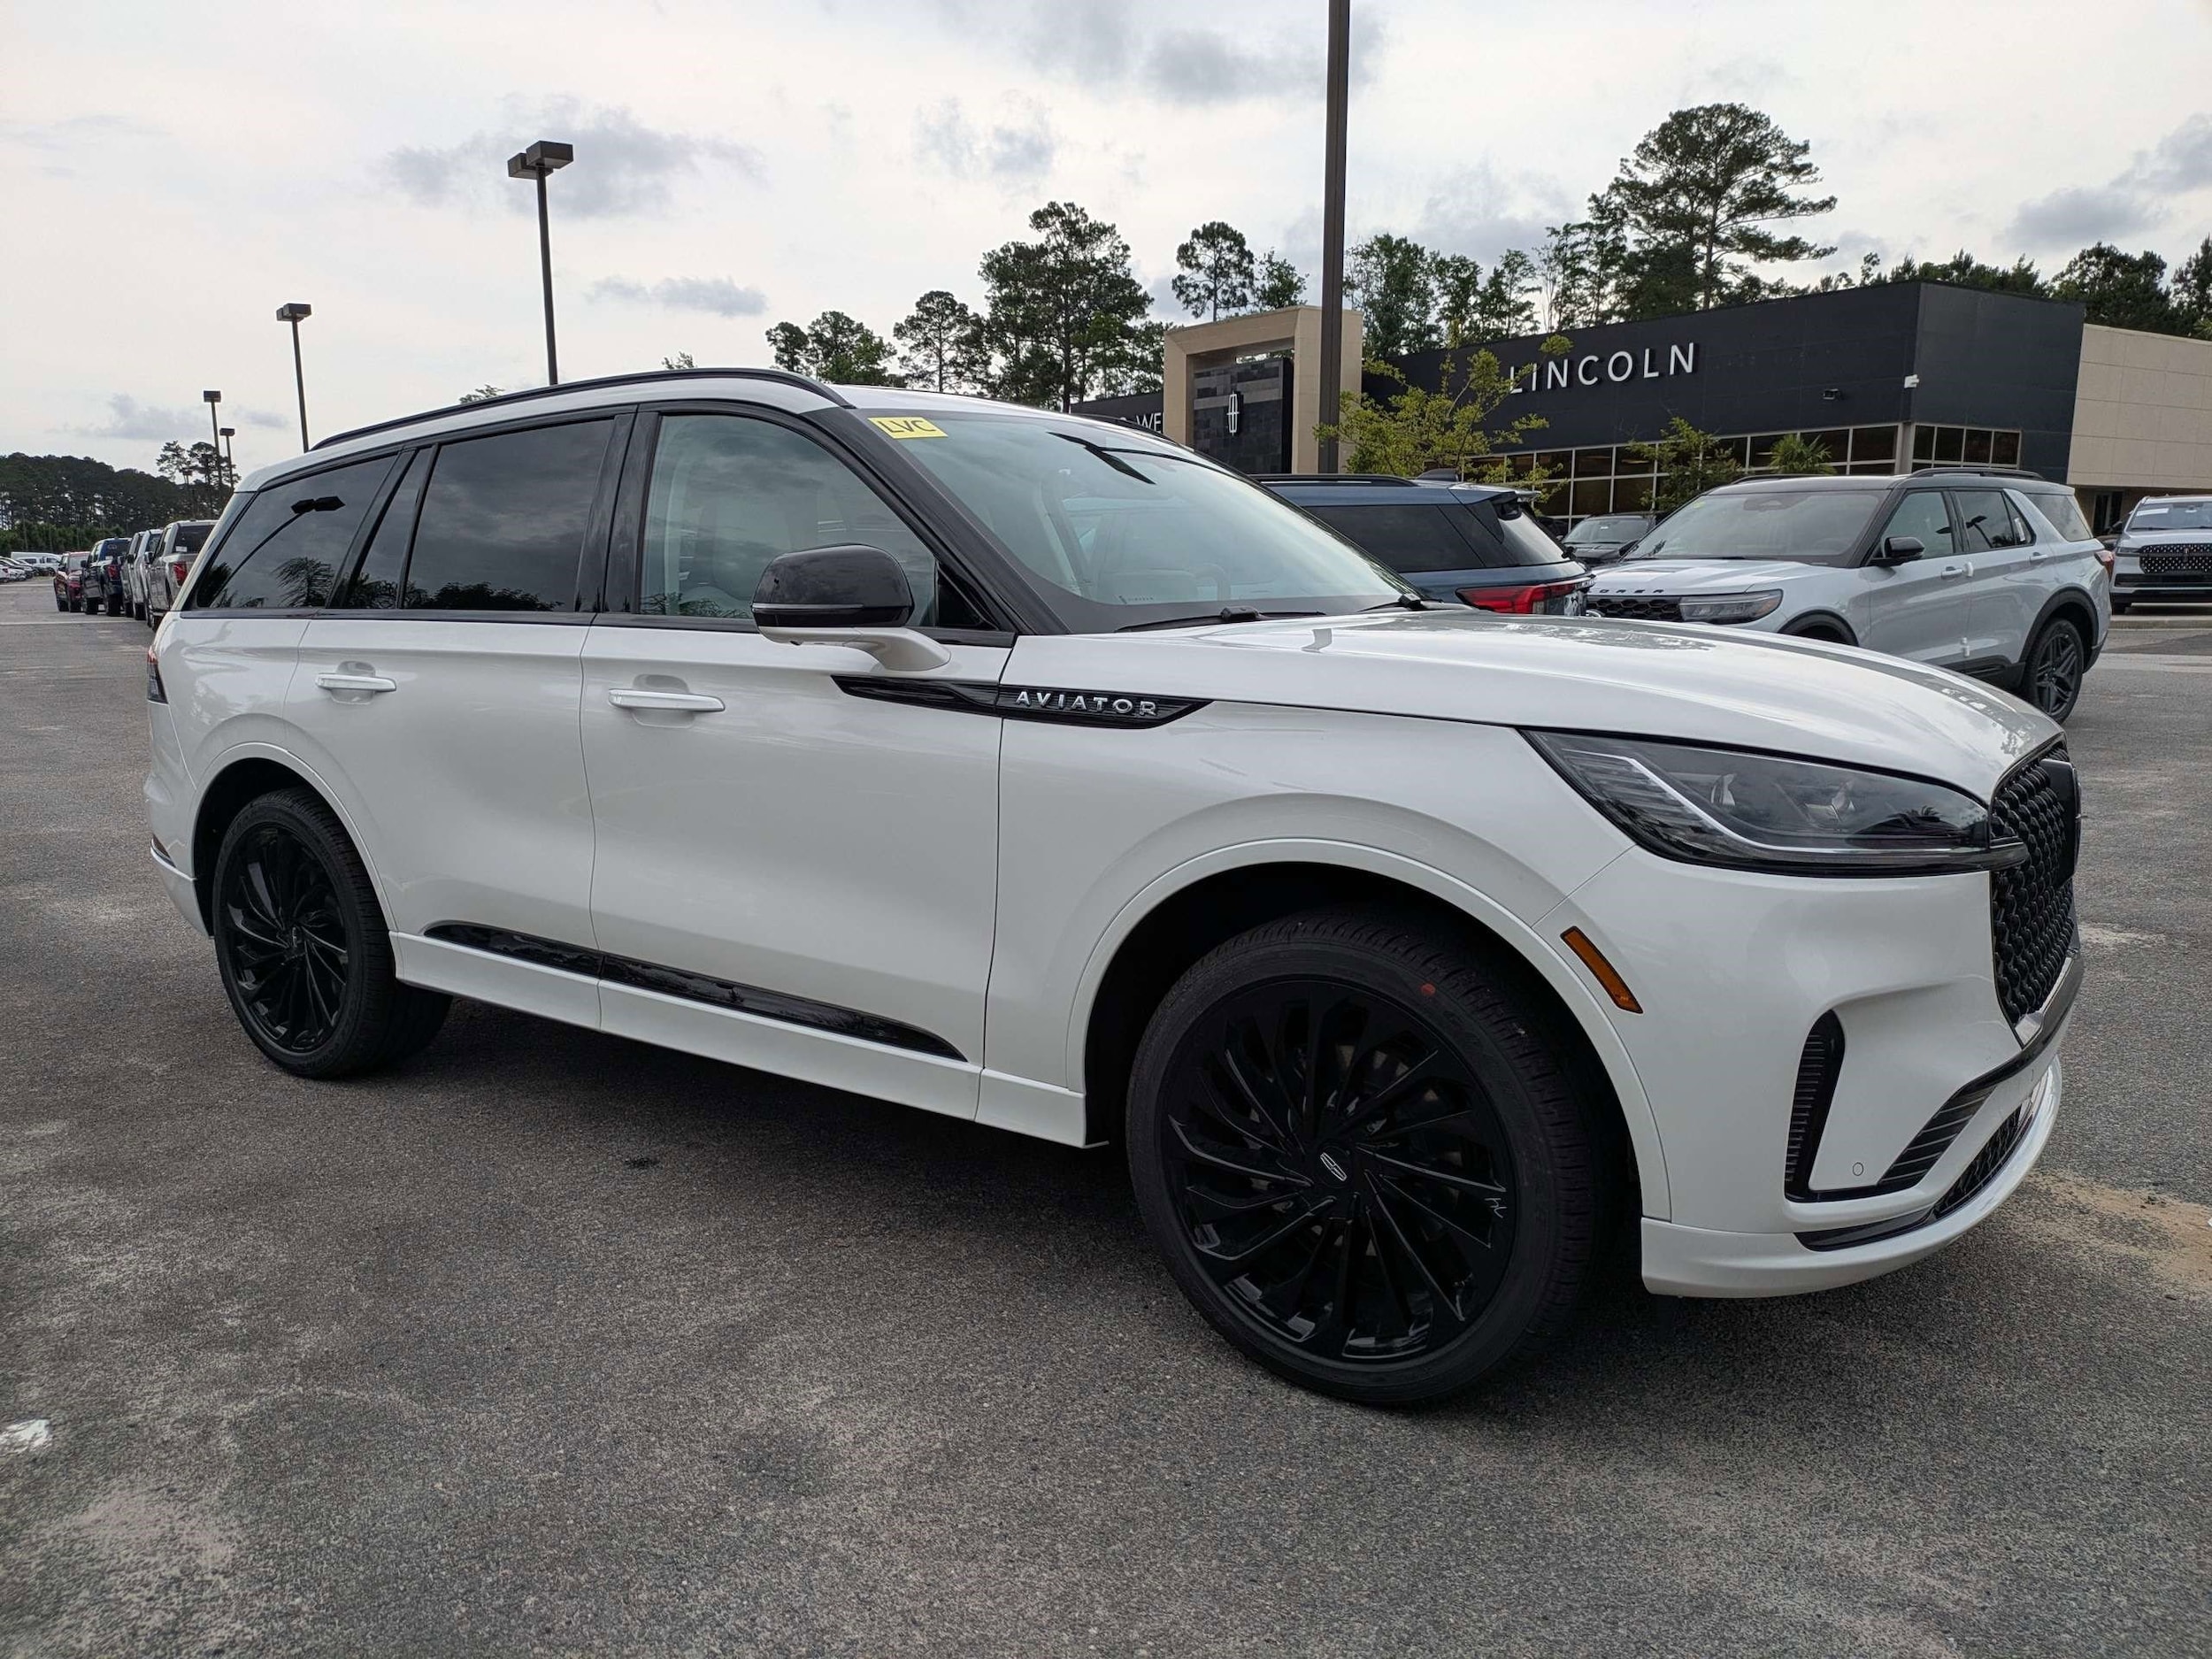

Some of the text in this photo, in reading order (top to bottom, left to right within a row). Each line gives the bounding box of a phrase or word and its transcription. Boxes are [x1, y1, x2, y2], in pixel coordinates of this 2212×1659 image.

[1509, 342, 1694, 395] LINCOLN
[877, 419, 937, 434] LVC
[1015, 690, 1157, 717] AVIATOR
